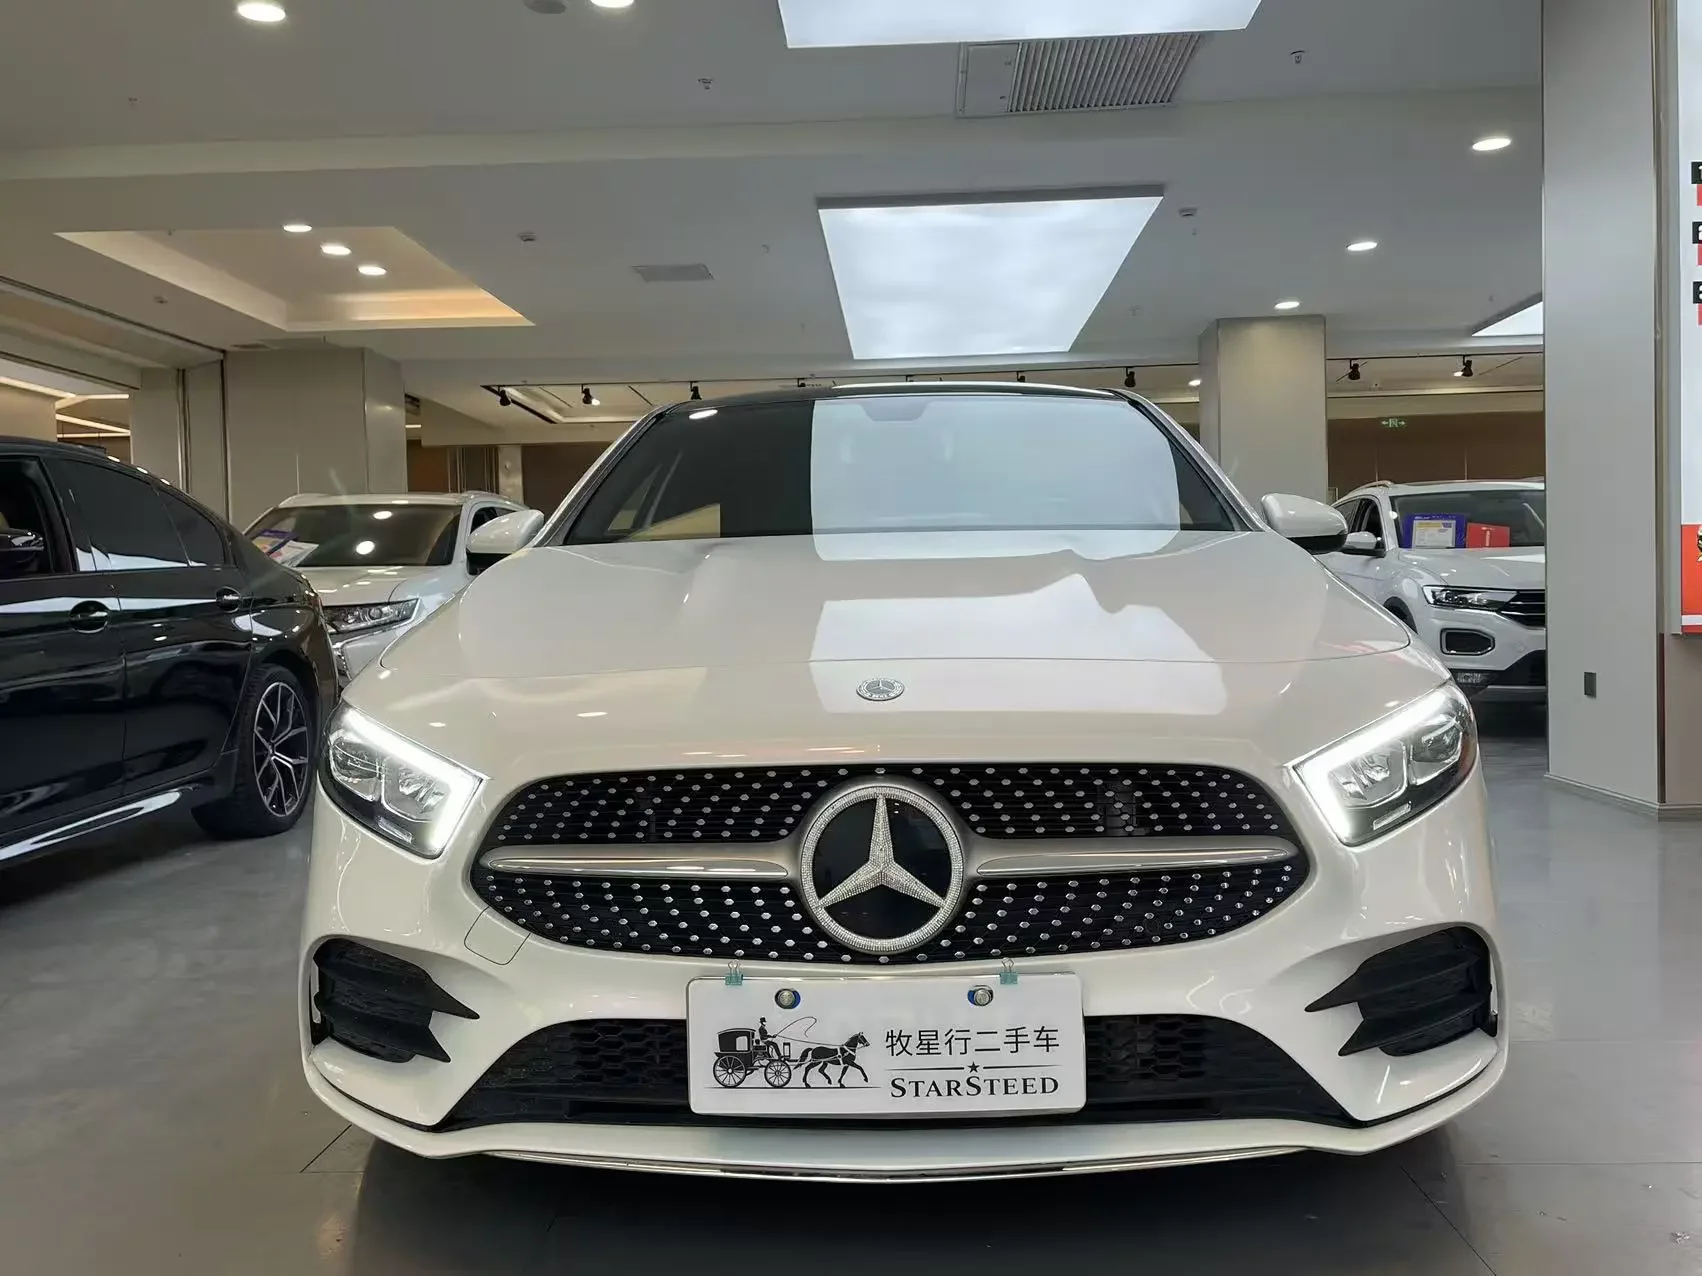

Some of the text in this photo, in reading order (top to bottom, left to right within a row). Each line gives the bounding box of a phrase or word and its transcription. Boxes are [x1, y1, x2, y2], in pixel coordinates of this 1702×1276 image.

[885, 1026, 1060, 1057] 牧星行二手车
